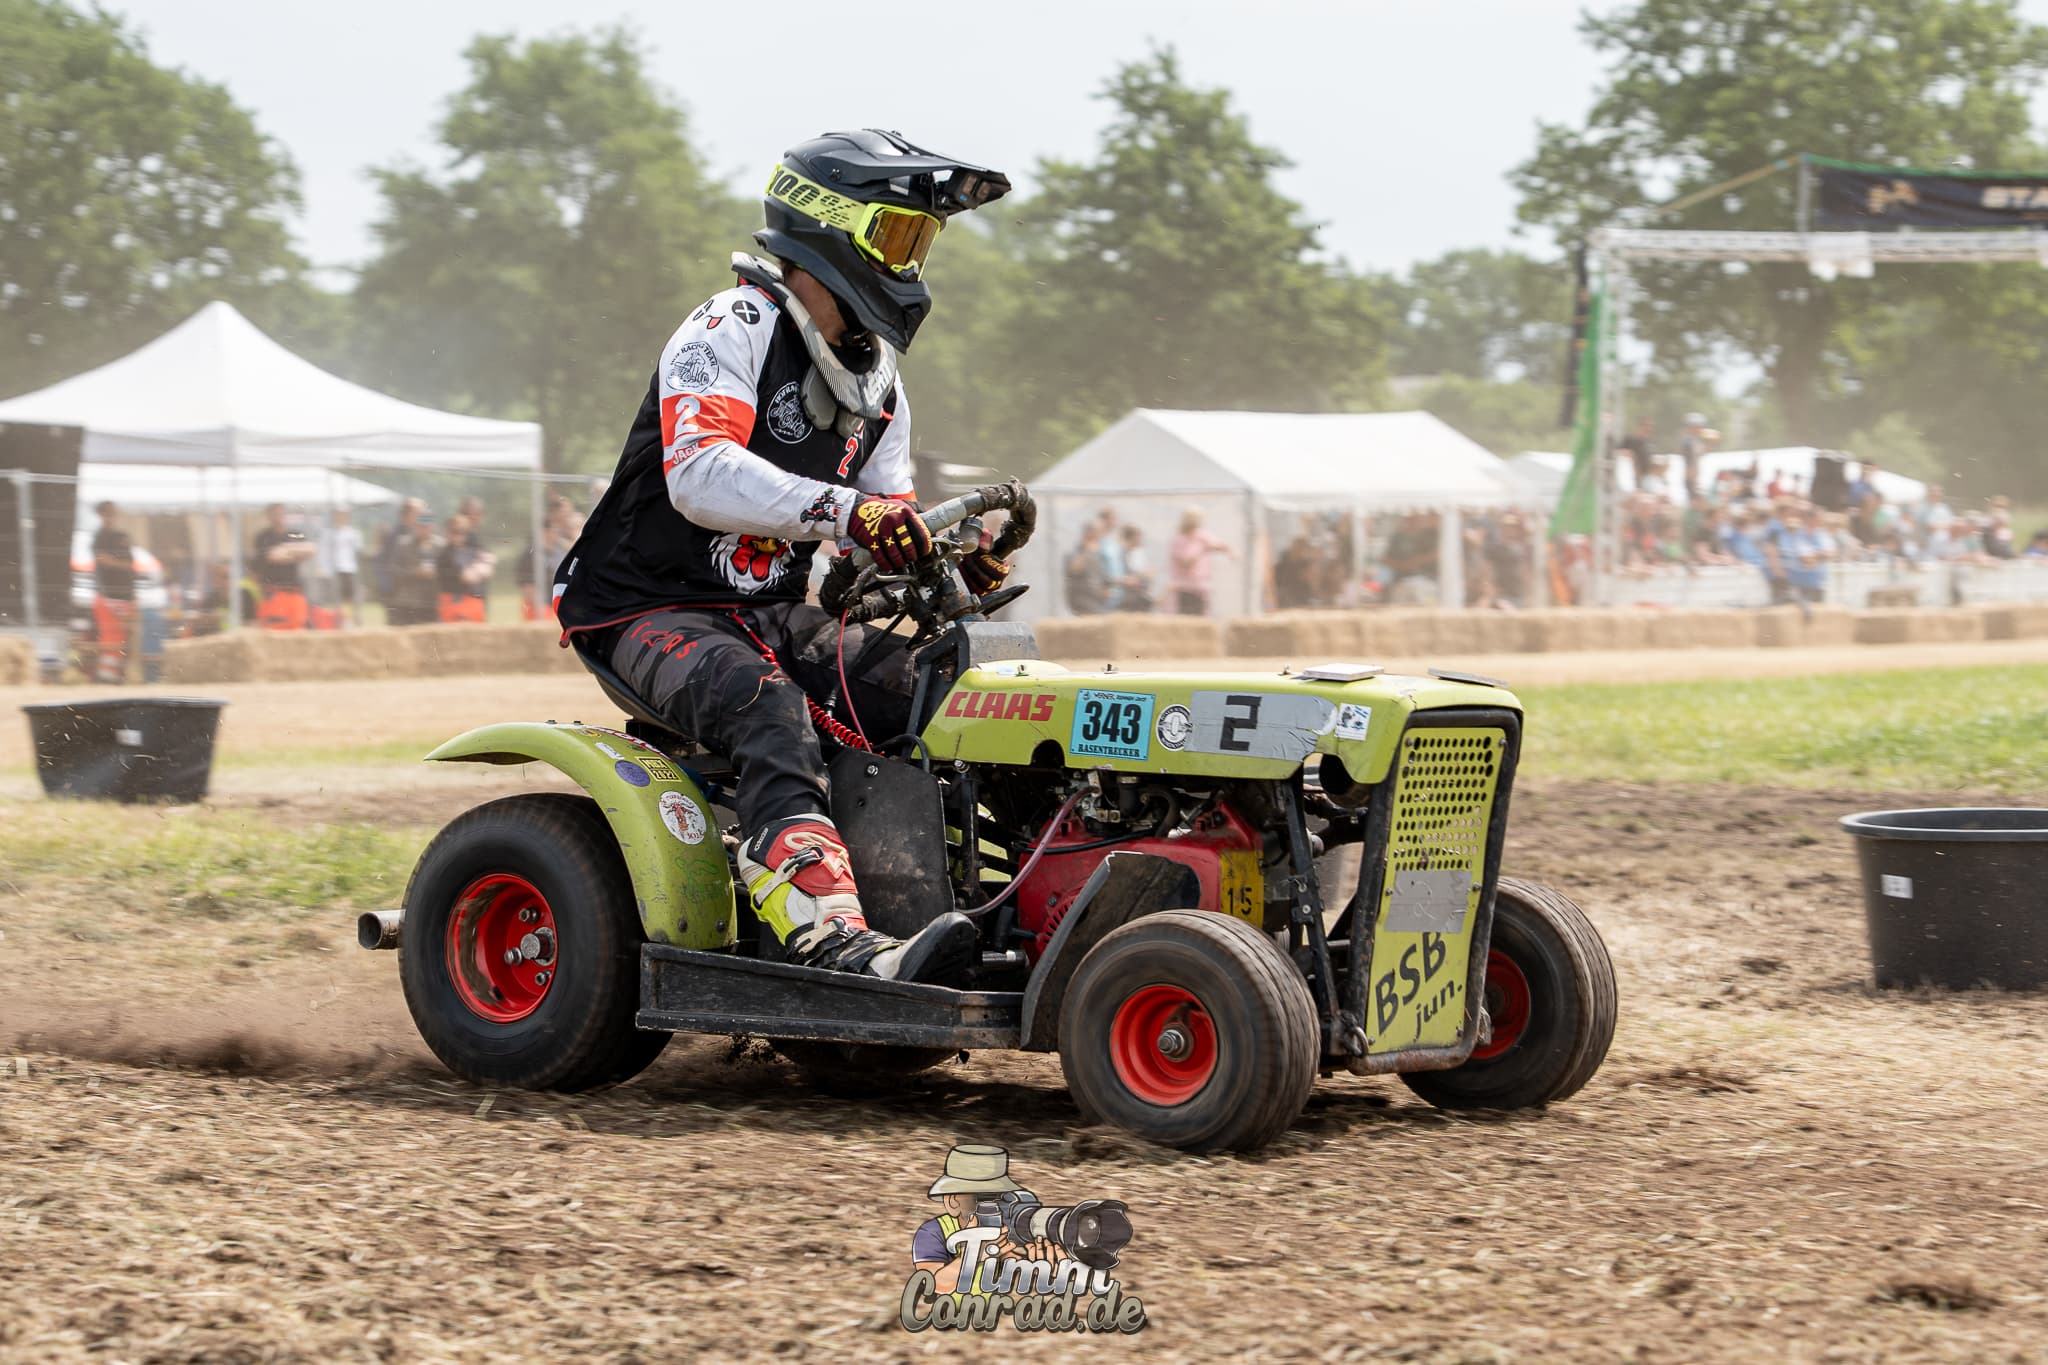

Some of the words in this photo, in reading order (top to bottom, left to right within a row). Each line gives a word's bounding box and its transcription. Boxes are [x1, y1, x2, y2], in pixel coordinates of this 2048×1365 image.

[675, 396, 700, 438] 2
[836, 436, 859, 479] 2
[945, 692, 1056, 721] CLAAS
[1082, 701, 1142, 745] 343
[1220, 695, 1262, 751] 2
[1227, 887, 1252, 916] 15
[1375, 931, 1446, 1035] BSB
[1413, 980, 1463, 1043] jun.
